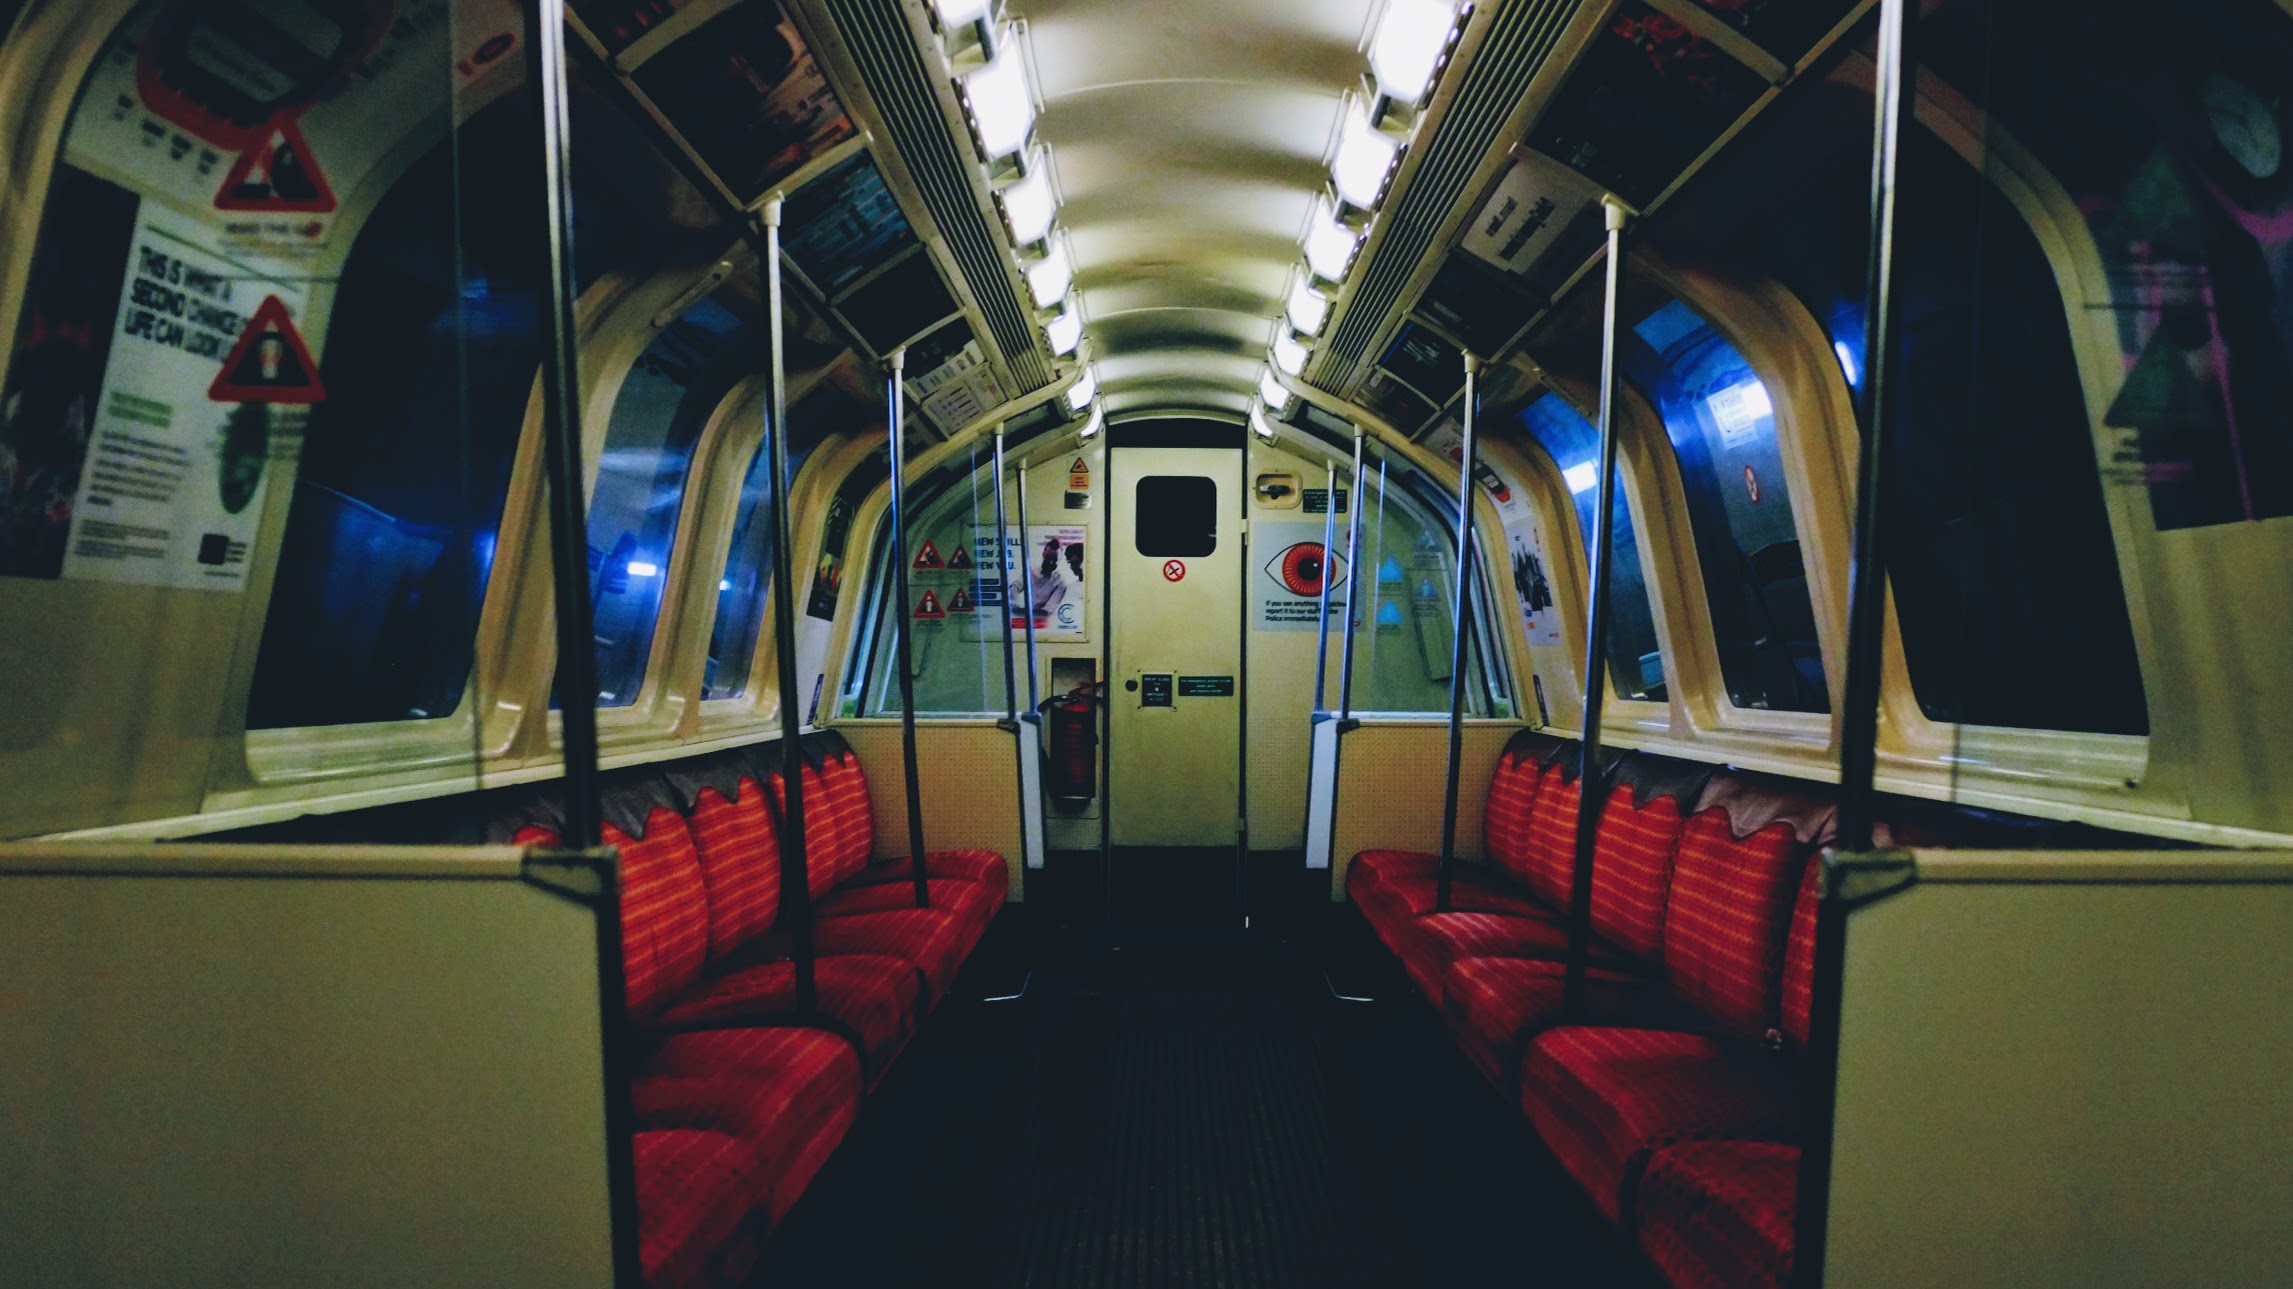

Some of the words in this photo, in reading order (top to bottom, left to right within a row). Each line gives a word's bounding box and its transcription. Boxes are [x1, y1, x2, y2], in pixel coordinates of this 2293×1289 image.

[139, 244, 168, 279] THIS
[168, 259, 182, 285] IS
[130, 276, 186, 317] SECOND
[124, 306, 156, 340] LIFE
[156, 317, 185, 348] CAN
[974, 537, 994, 546] NEW
[995, 549, 1014, 558] JB.
[995, 561, 1016, 570] YU.
[1294, 600, 1319, 608] anything
